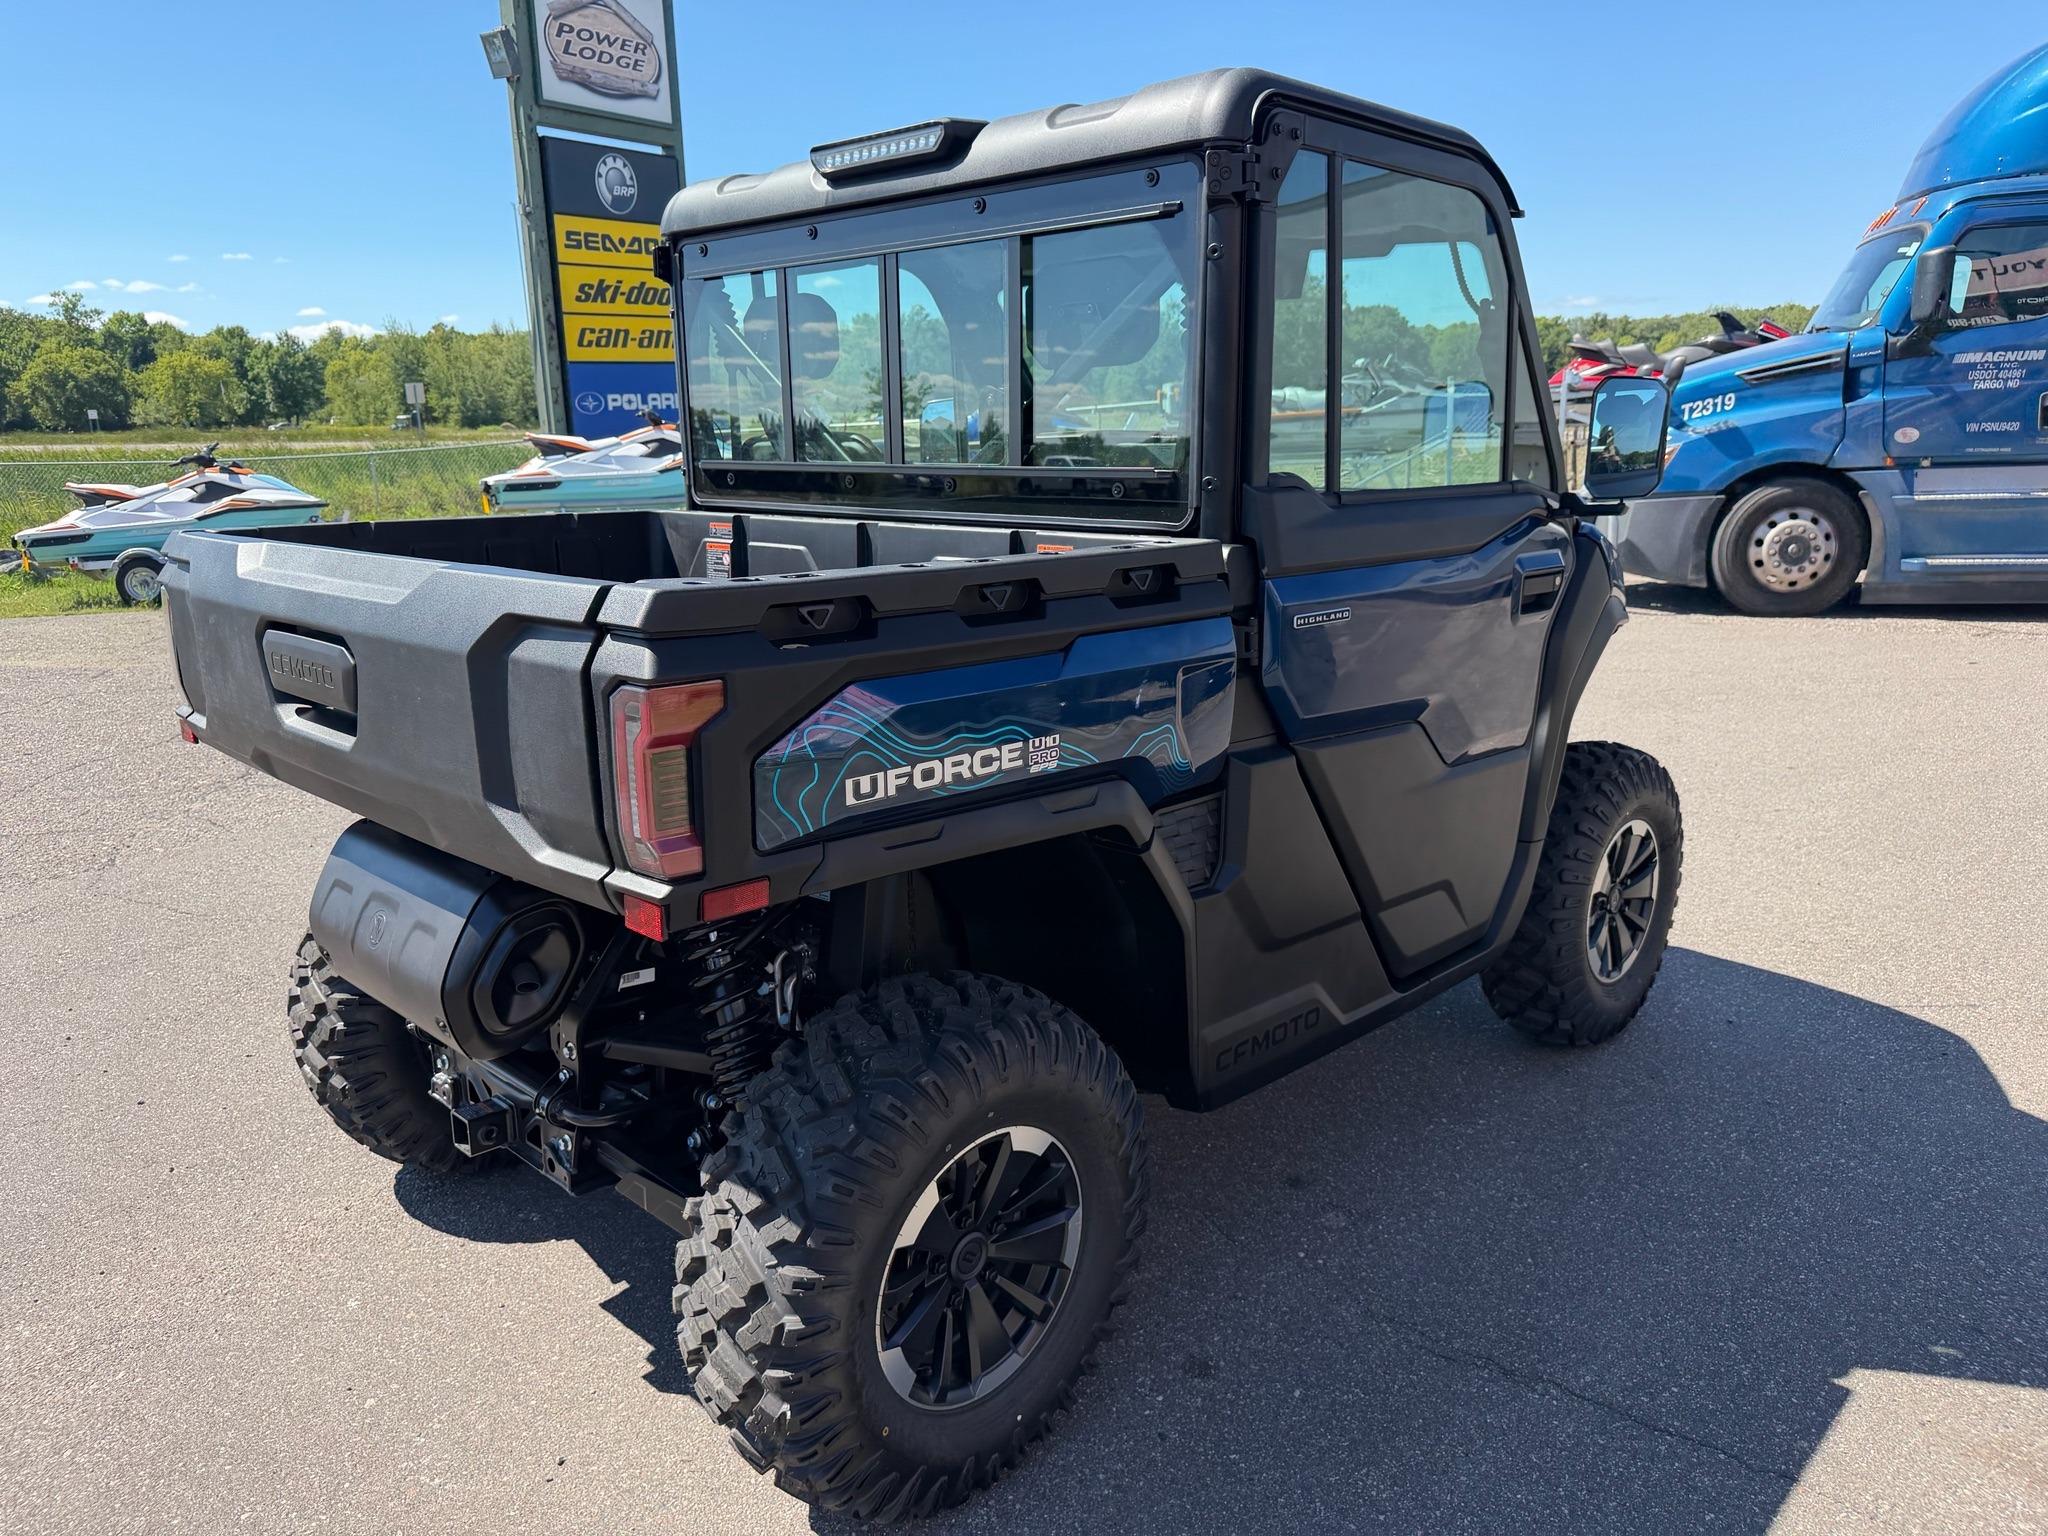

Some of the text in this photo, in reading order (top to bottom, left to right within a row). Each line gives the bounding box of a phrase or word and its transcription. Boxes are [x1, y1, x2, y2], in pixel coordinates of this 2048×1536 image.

[555, 22, 648, 57] POWER
[562, 39, 646, 73] LODGE
[613, 185, 635, 197] BRP
[575, 279, 671, 306] ski-doo
[577, 327, 674, 349] can-am
[1963, 350, 2046, 363] MAGNUM
[1968, 369, 2026, 380] USDOT 404961
[1973, 379, 2020, 390] FARGO, ND
[607, 392, 679, 411] POLARI
[1681, 392, 1736, 421] T2319
[1966, 421, 2020, 432] VIN PSNU9420
[1297, 611, 1349, 625] HIGHLAND
[271, 651, 334, 689] CFMOTO
[1029, 734, 1060, 752] U10
[1029, 748, 1060, 765] PRO
[845, 741, 1024, 806] UFORCE
[1030, 760, 1059, 773] EPS
[1216, 1006, 1320, 1072] CFMOTO
